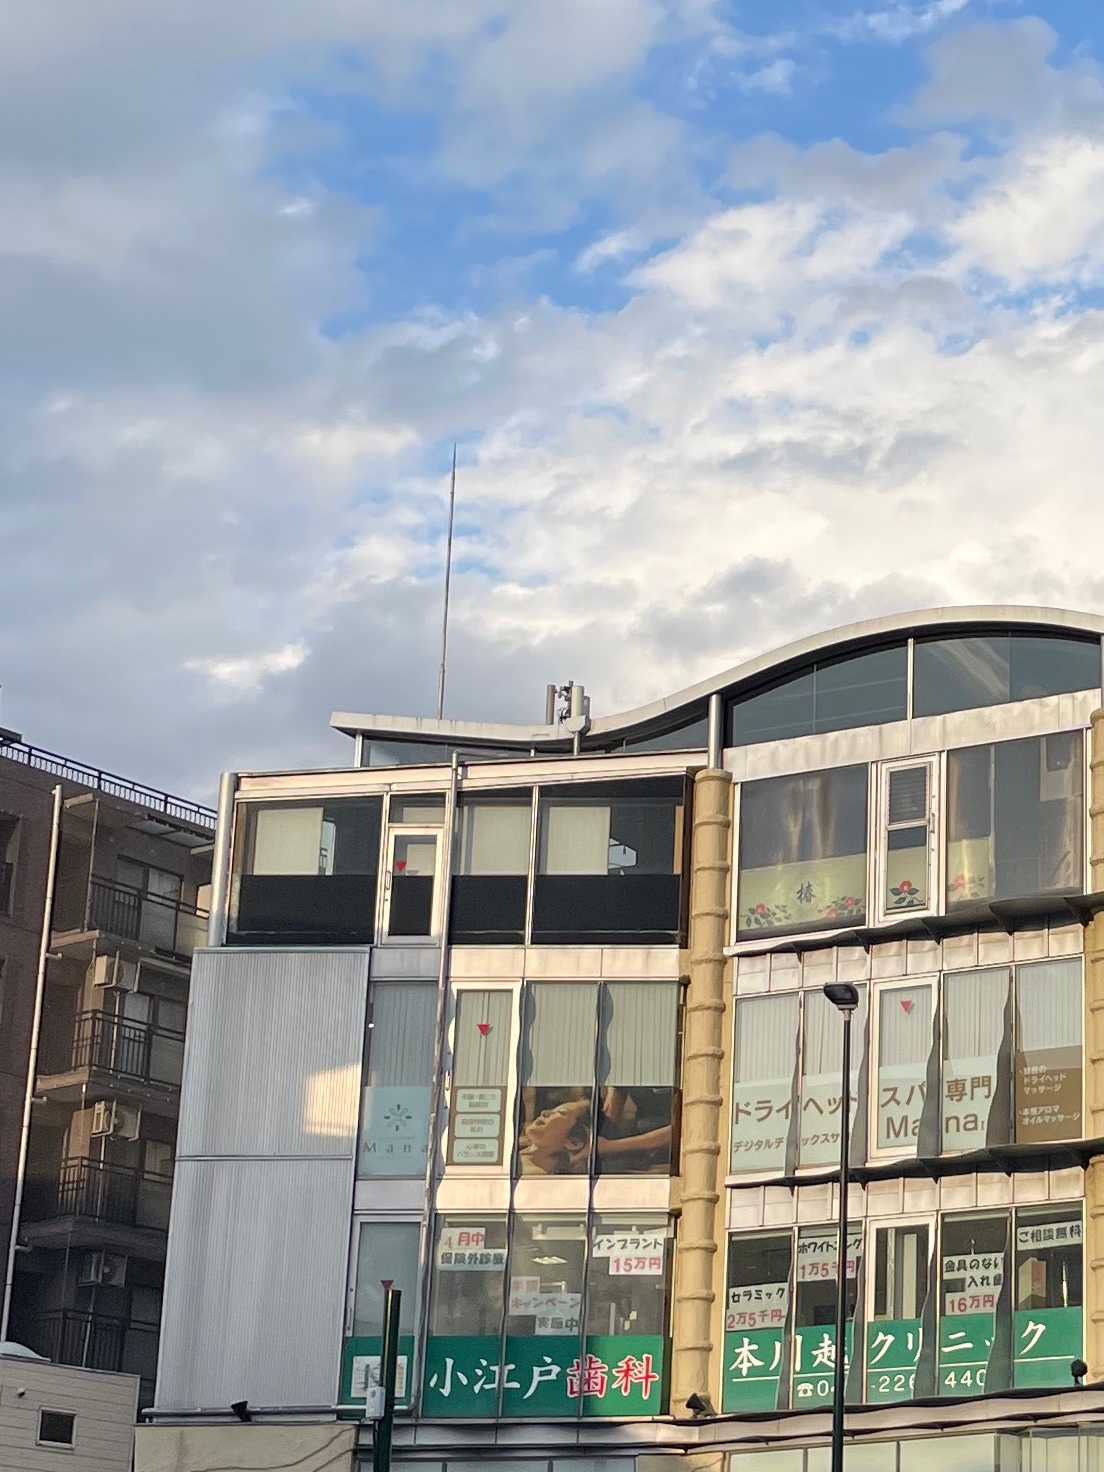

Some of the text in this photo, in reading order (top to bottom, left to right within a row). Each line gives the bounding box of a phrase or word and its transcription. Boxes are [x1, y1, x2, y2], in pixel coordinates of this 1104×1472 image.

[733, 1133, 840, 1153] デジタルデックスサ
[593, 1236, 663, 1250] インプラント
[612, 1255, 662, 1273] 15万円
[731, 1287, 785, 1303] セラミック
[949, 1294, 995, 1313] 16万円
[429, 1355, 659, 1400] 小江戸歯科
